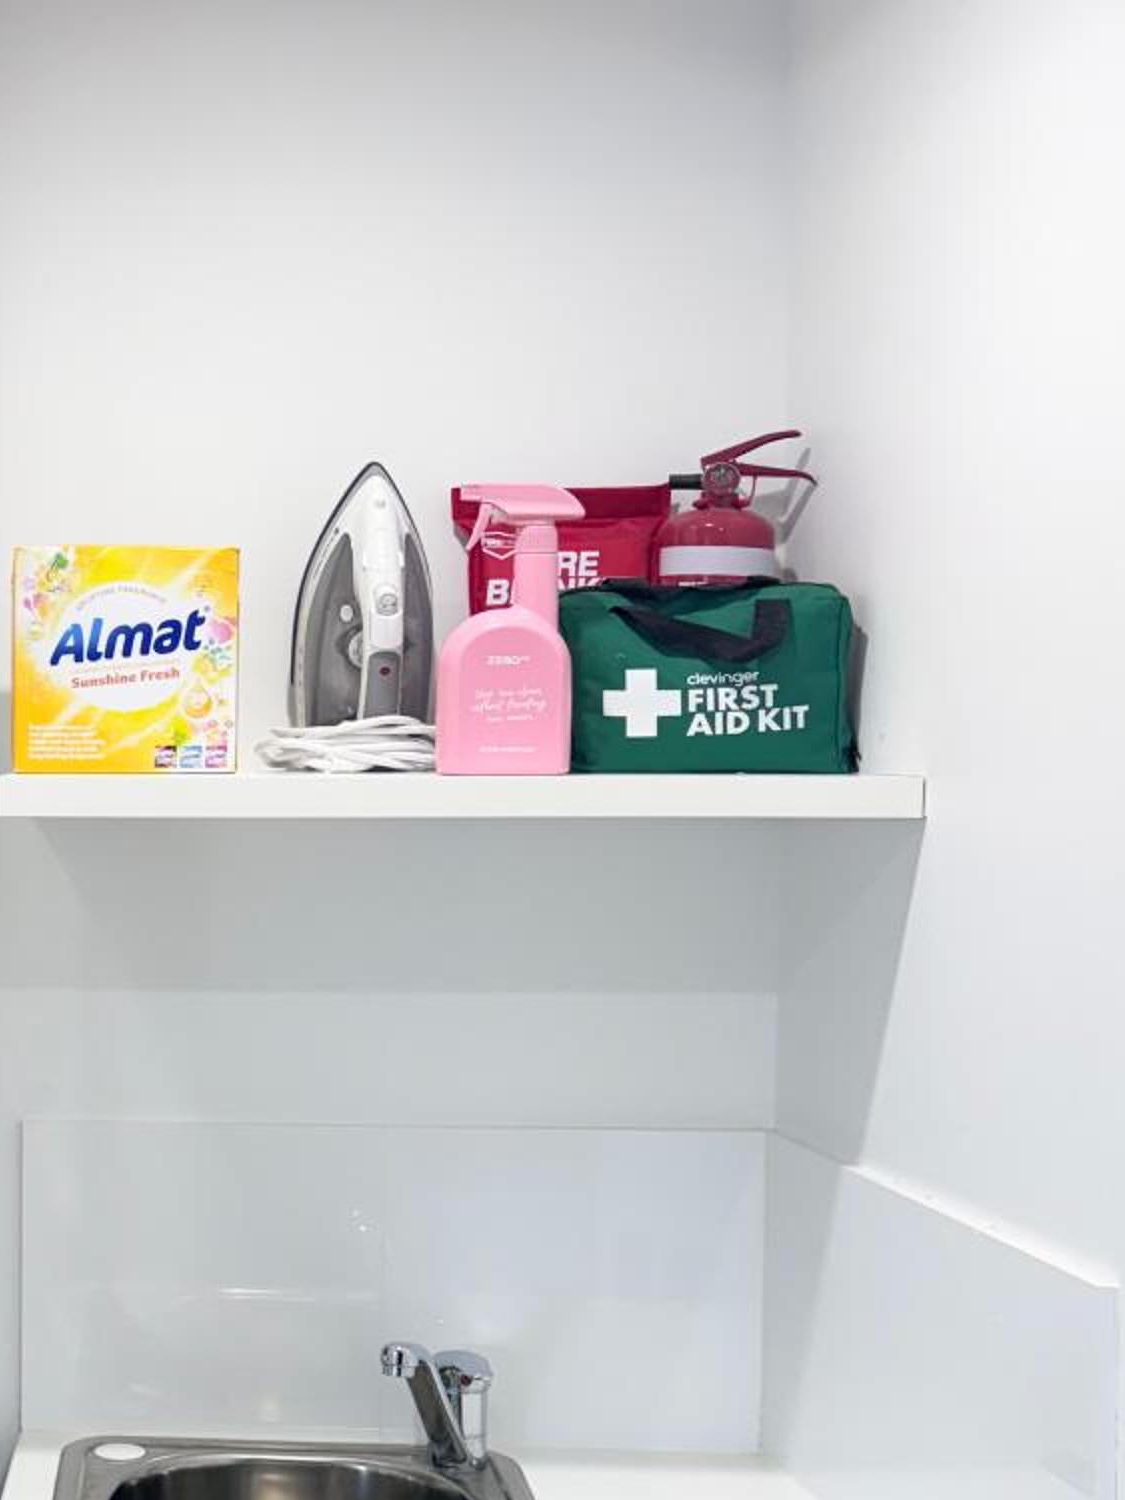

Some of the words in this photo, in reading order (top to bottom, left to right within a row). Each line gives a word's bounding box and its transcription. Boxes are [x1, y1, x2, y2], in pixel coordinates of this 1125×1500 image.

[557, 551, 600, 577] RE
[50, 609, 206, 666] Almat
[71, 672, 137, 688] Sunshine
[140, 667, 180, 681] Fresh
[686, 671, 760, 687] clevinger
[688, 683, 778, 712] FIRST
[686, 711, 750, 736] AID
[758, 704, 809, 732] KIT
